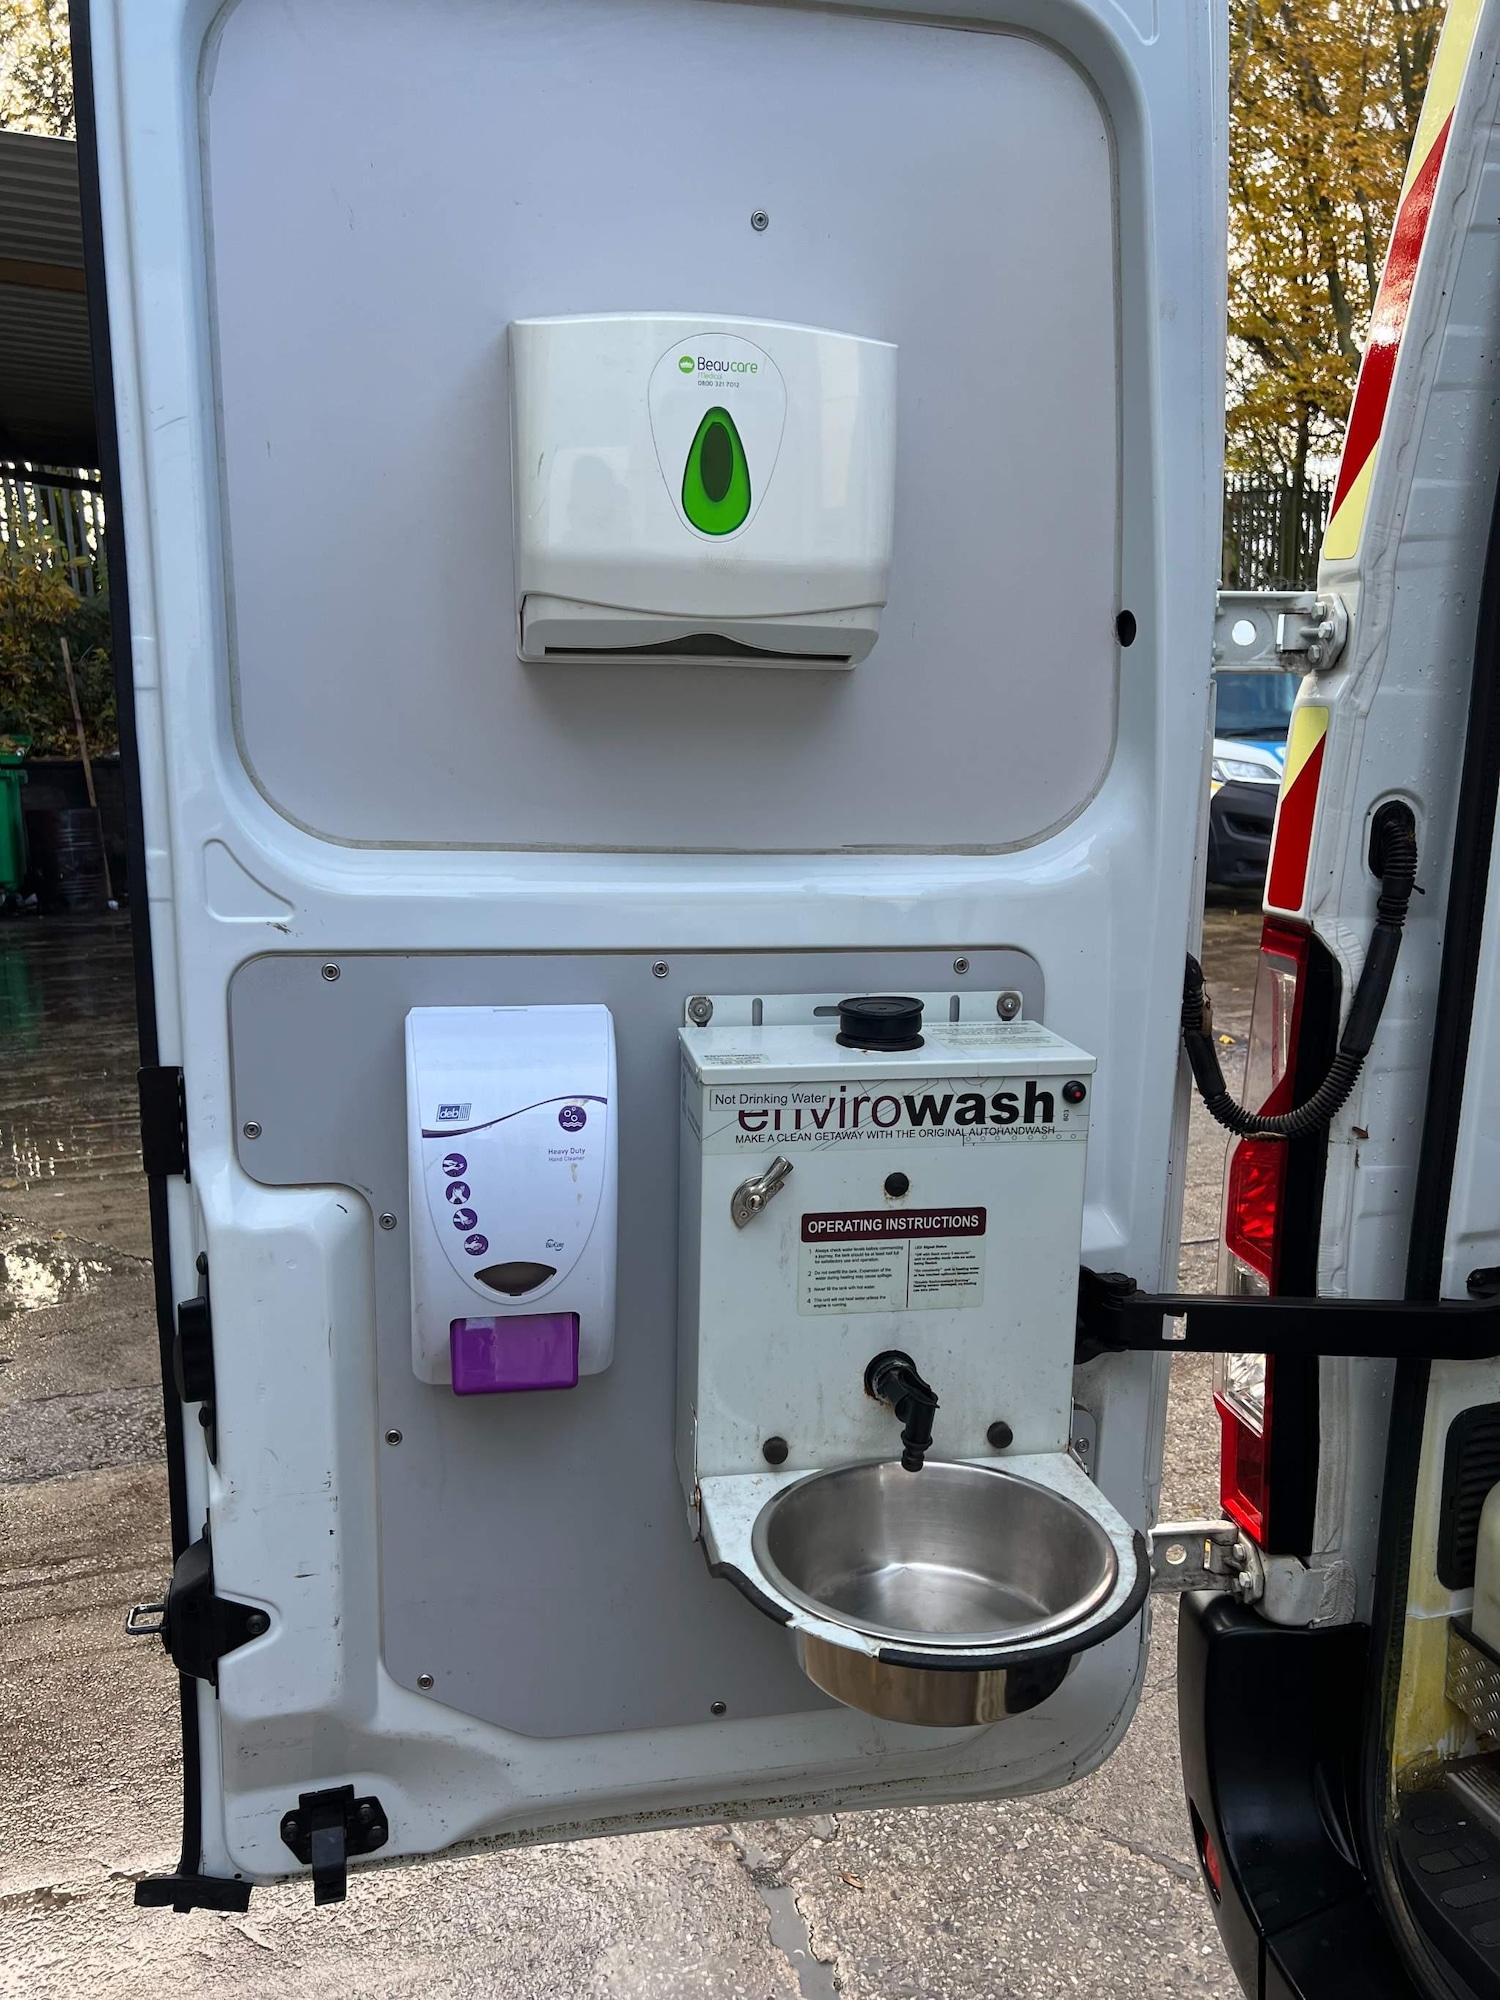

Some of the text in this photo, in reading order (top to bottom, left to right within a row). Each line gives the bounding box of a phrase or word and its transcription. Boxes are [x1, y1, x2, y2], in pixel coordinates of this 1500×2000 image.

[697, 356, 758, 374] Beaucare
[715, 1092, 827, 1106] Not Drinking Water
[440, 1107, 459, 1118] deb
[735, 1126, 1056, 1144] MAKE A CLEAN GETAWAY WITH THE ORIGINAL AUTOHANDWASH
[807, 1214, 980, 1234] OPERATING INSTRUCTIONS
